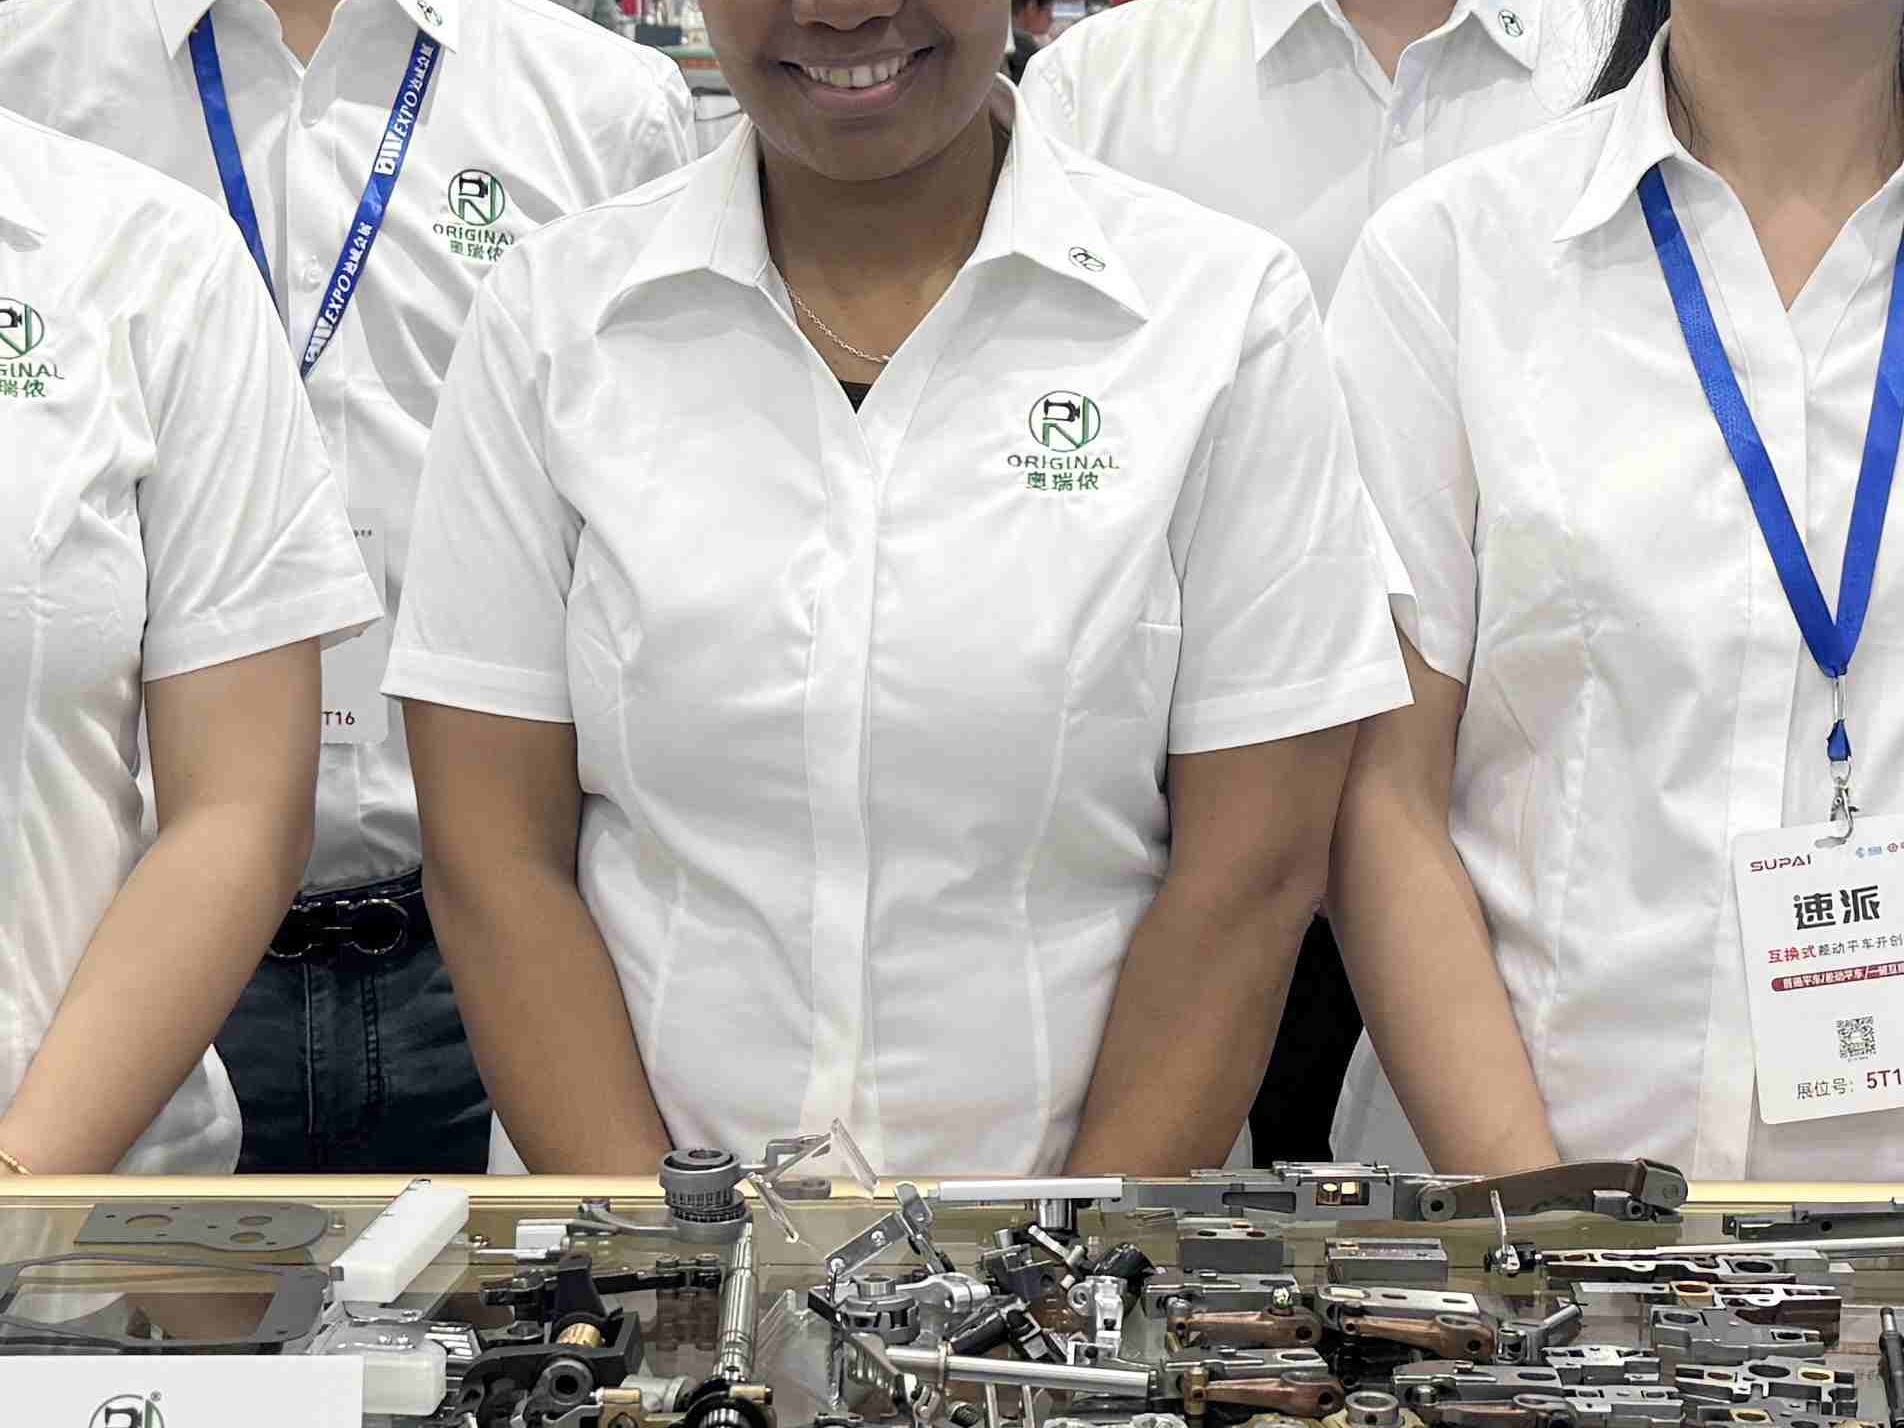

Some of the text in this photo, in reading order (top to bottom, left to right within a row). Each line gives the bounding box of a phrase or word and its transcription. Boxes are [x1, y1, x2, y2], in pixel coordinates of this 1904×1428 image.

[325, 274, 352, 323] EXPO
[1006, 453, 1120, 471] ORIGINAL
[1749, 853, 1813, 872] SUPAI
[1792, 884, 1881, 931] 速派
